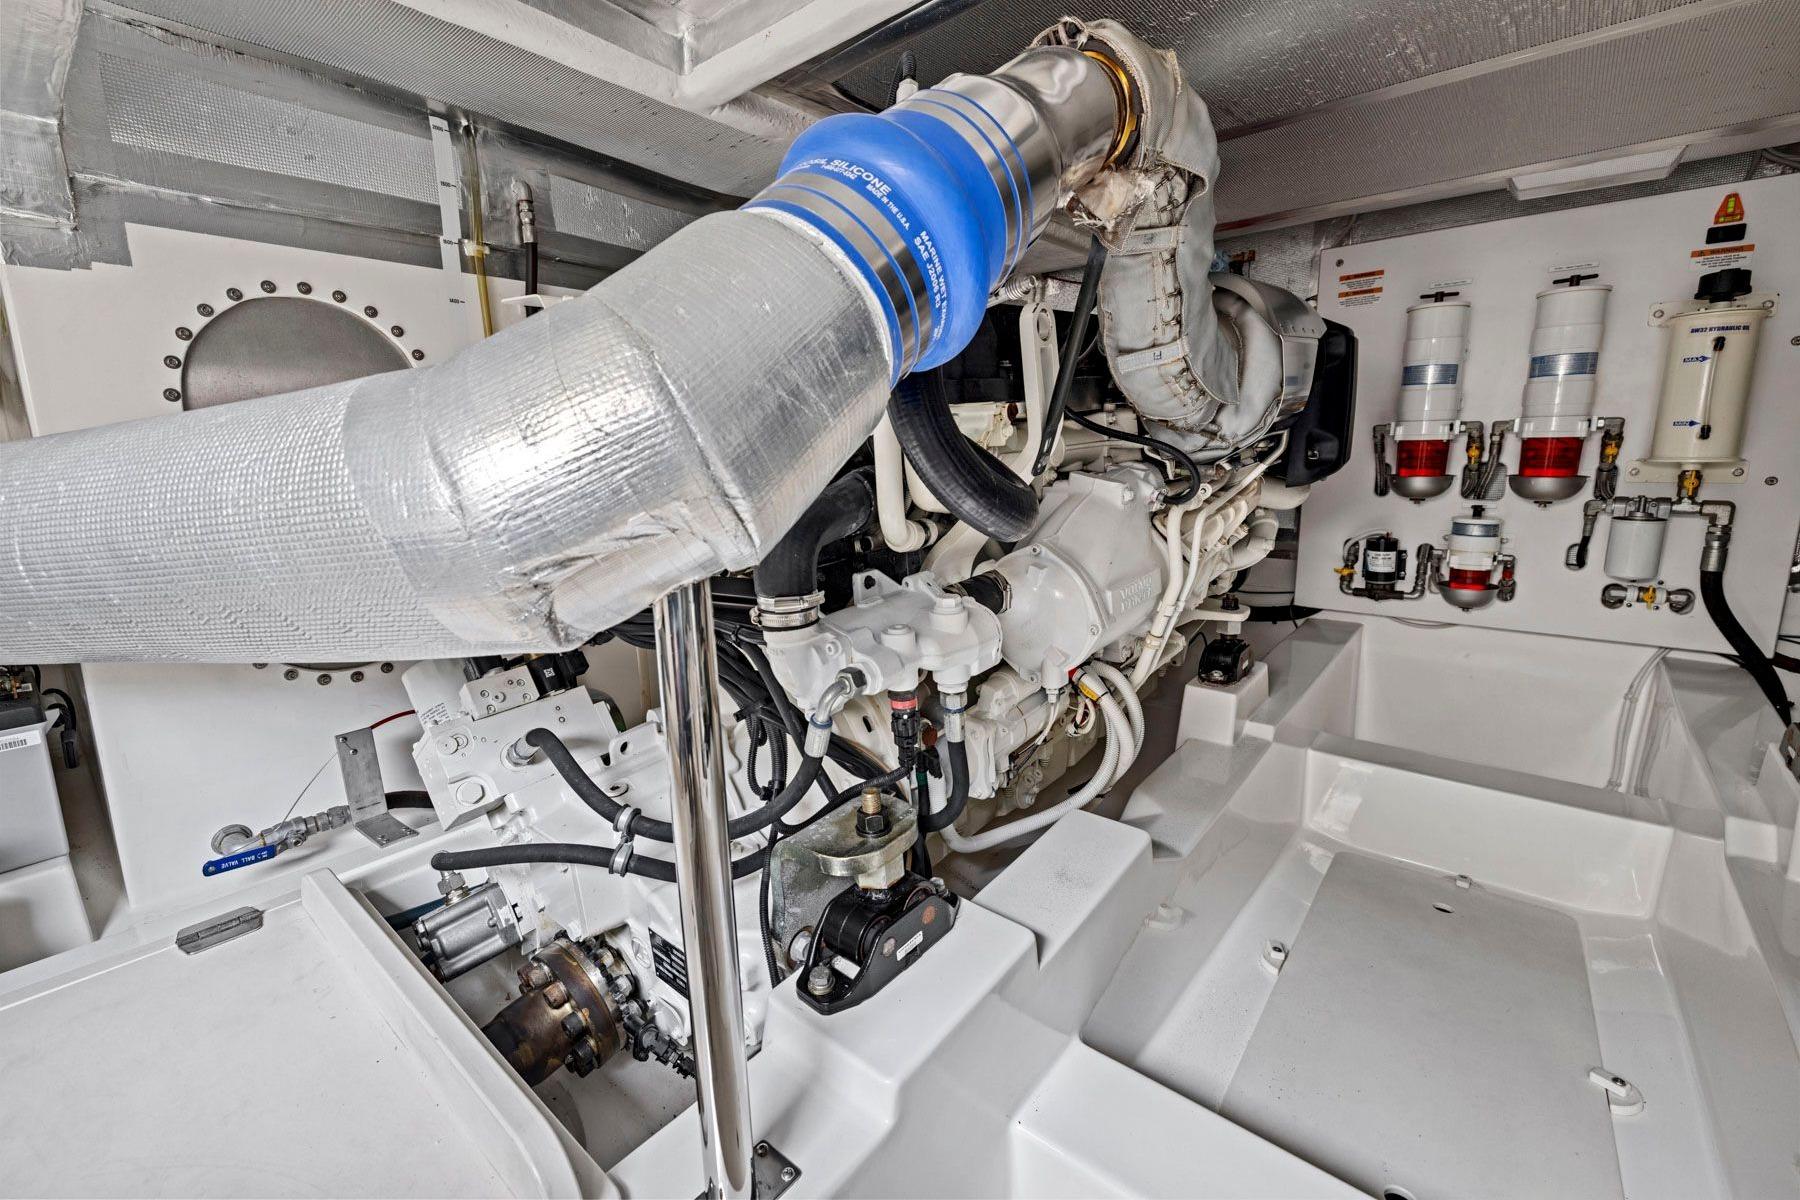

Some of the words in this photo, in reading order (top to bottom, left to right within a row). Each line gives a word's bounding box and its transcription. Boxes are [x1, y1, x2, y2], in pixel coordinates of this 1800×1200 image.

[830, 159, 892, 196] SILICONE
[865, 183, 882, 199] MADE
[887, 202, 900, 215] THE
[914, 236, 930, 261] SAE
[920, 230, 943, 275] MARINE
[938, 275, 948, 299] WET
[221, 860, 239, 869] VALVE
[241, 855, 256, 863] BALL
